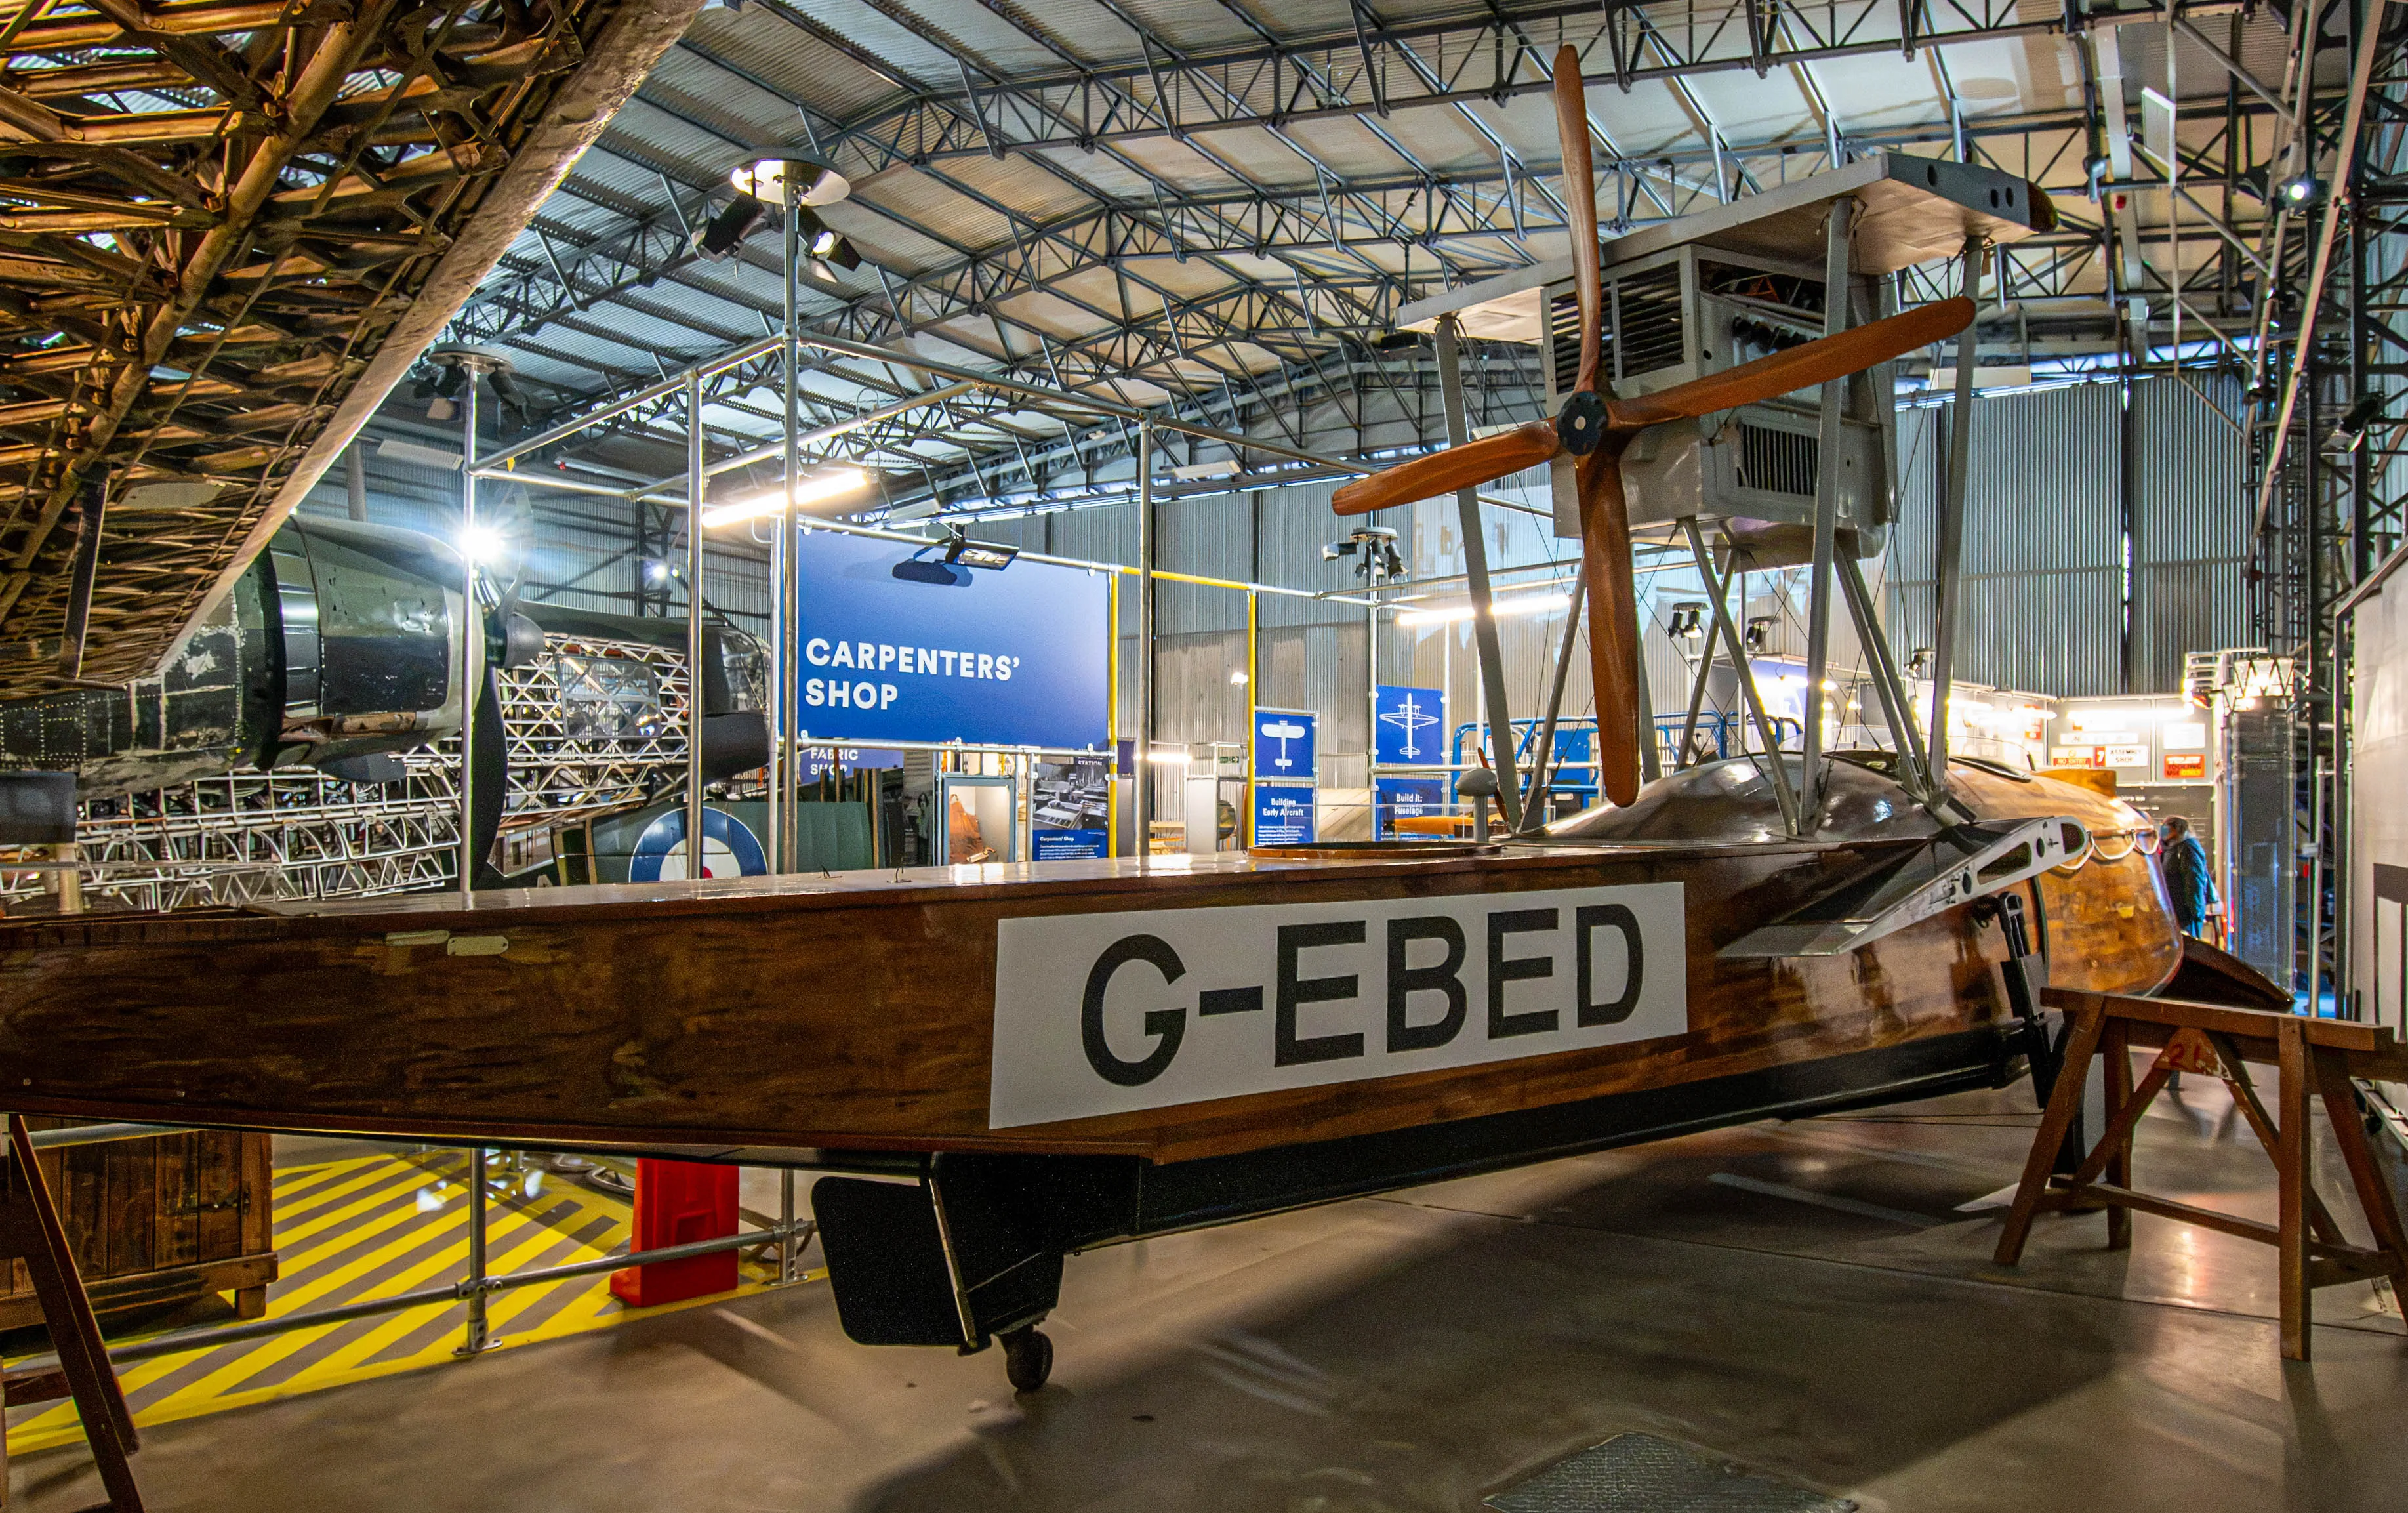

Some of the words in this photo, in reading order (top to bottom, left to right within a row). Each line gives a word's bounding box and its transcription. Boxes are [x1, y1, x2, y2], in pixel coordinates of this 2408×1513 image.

[806, 638, 1020, 681] CARPENTERS’
[805, 678, 898, 710] SHOP
[810, 747, 859, 761] FABRIC
[1271, 797, 1296, 808] Building
[1396, 793, 1414, 802] Build
[1263, 808, 1279, 818] Early
[1280, 808, 1304, 816] Arcraft
[1080, 903, 1644, 1087] G-EBED
